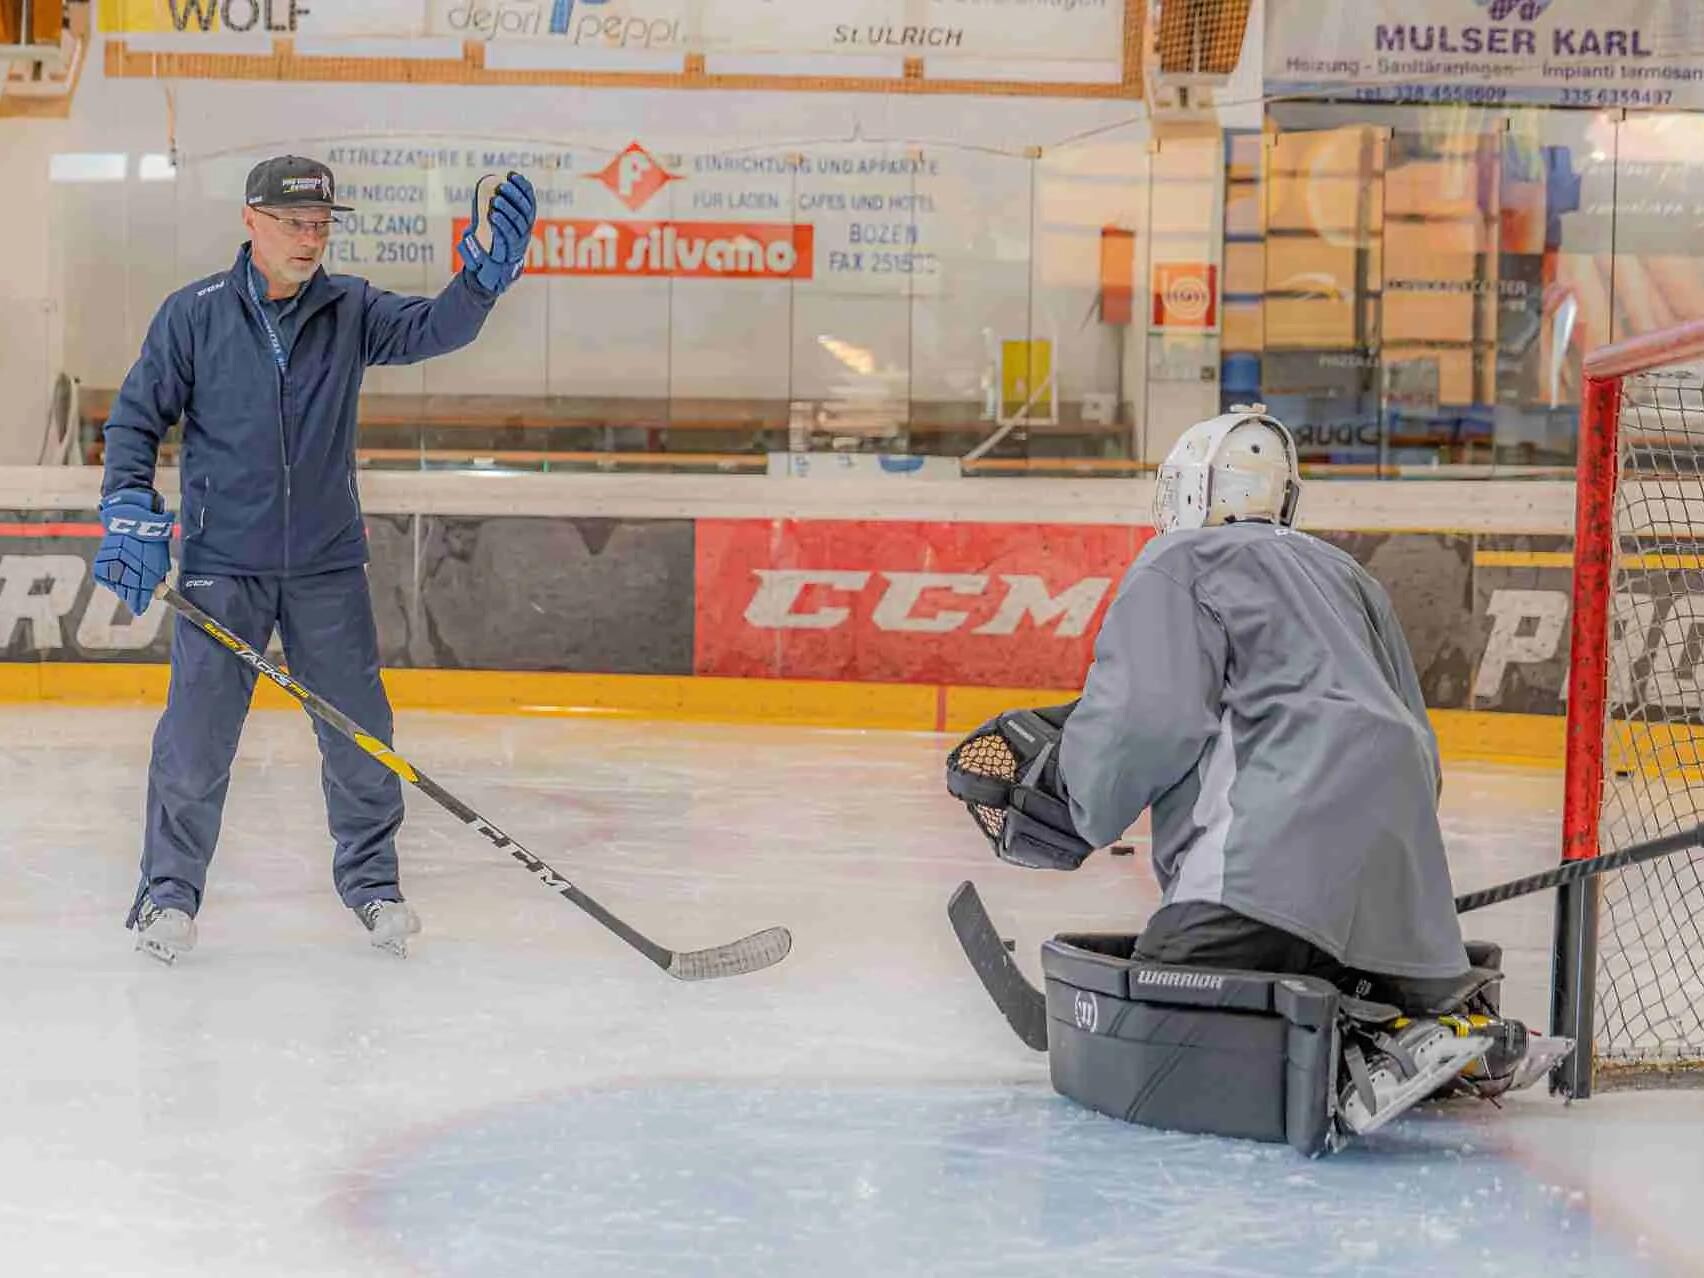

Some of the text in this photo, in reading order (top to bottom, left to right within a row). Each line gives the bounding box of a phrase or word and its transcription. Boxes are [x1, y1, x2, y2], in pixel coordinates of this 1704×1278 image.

[168, 0, 310, 32] WOLF
[1375, 25, 1652, 57] MULSER KARL
[1286, 56, 1360, 77] Heizung
[1542, 60, 1615, 82] Impianti
[335, 185, 358, 200] ER
[333, 212, 428, 236] BOLZANO
[849, 223, 919, 244] BOZEN
[376, 241, 436, 263] 251011
[527, 224, 618, 271] ntini
[626, 226, 797, 272] silvano
[829, 251, 864, 272] FAX
[743, 568, 1113, 638] CCM
[1136, 969, 1226, 990] WARRIOR
